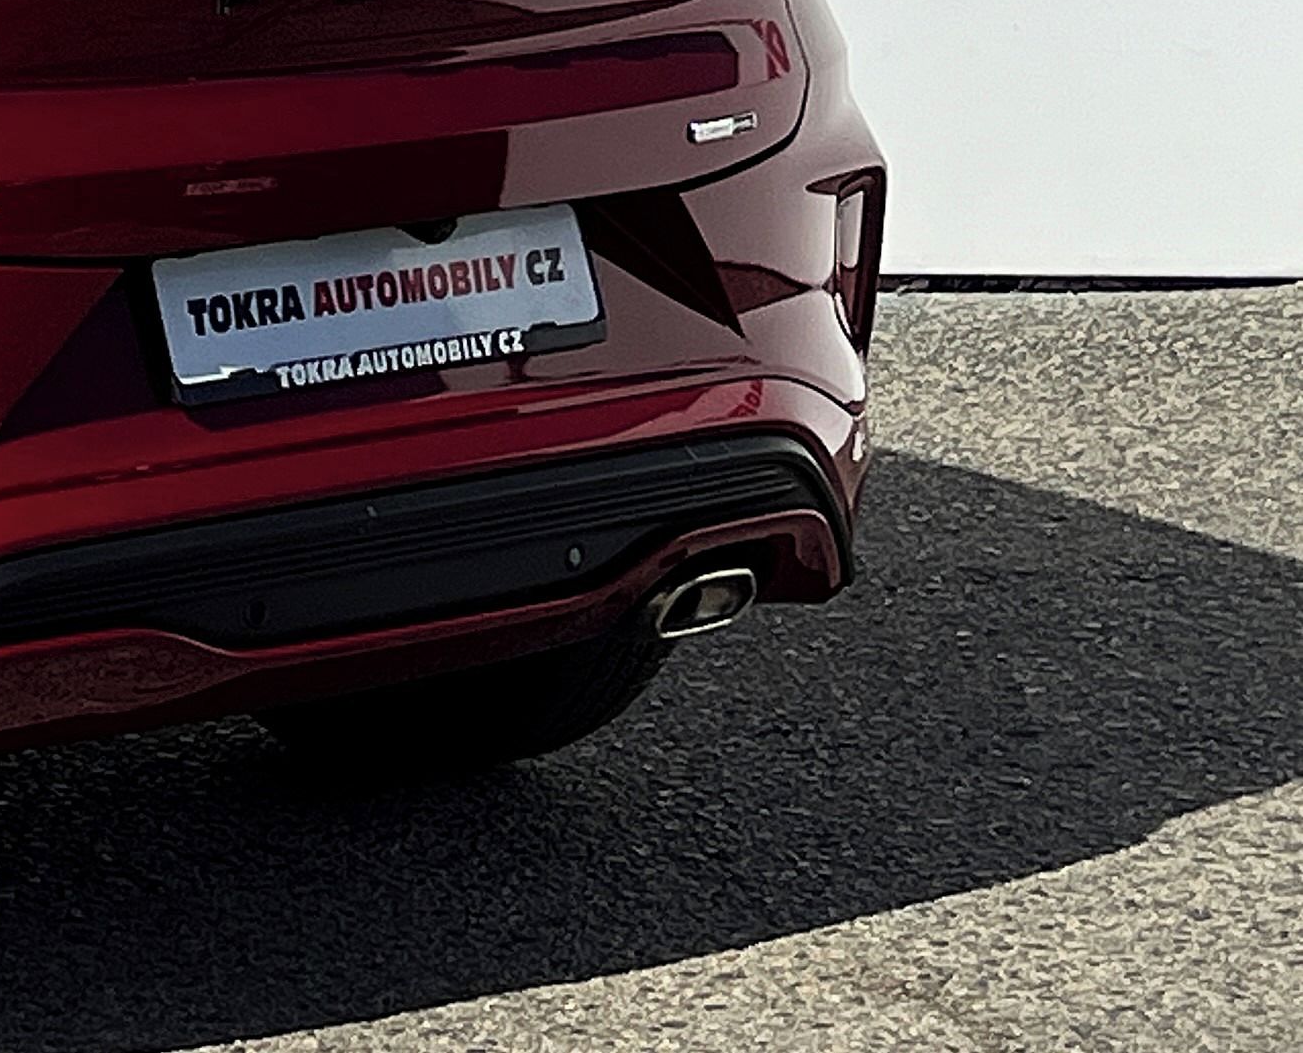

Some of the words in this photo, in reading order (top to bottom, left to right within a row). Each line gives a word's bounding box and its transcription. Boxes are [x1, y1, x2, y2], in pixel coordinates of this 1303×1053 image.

[186, 284, 305, 336] TOKRA
[312, 253, 517, 318] AUTOMOBILY
[524, 248, 565, 287] CZ
[275, 355, 354, 389] TOKRA
[355, 333, 494, 377] AUTOMOBILY
[498, 330, 525, 355] CZ
